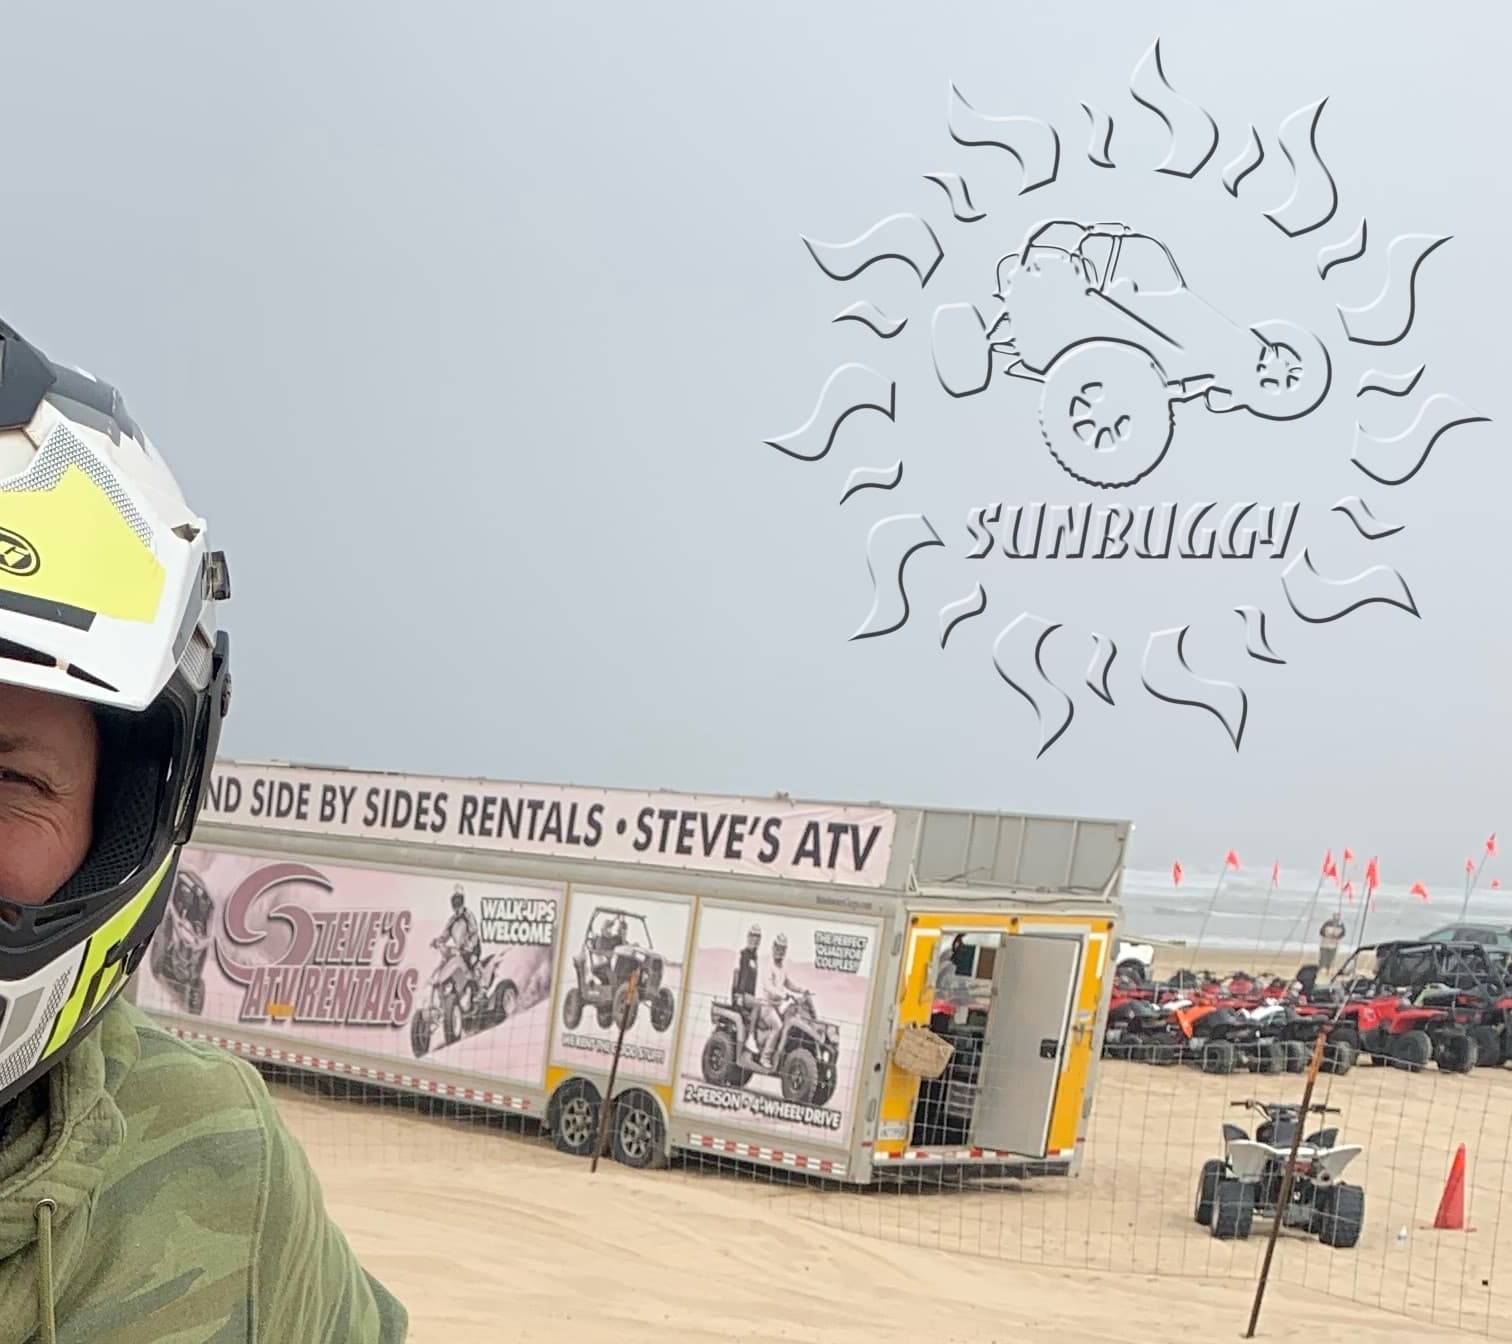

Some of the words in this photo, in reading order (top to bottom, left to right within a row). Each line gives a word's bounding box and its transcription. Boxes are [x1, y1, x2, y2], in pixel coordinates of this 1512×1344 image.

[249, 777, 311, 821] SIDE
[318, 783, 358, 825] BY
[362, 785, 449, 833] SIDES
[457, 792, 606, 848] RENTALS
[632, 806, 783, 865] STEVE'S
[791, 819, 883, 872] ATV
[215, 862, 412, 984] STEVE'S
[481, 898, 557, 922] WALK-UPS
[481, 920, 553, 945] WELCOME
[241, 966, 300, 1021] ATV
[294, 967, 419, 1028] RENTALS
[804, 1107, 841, 1130] DRIVE
